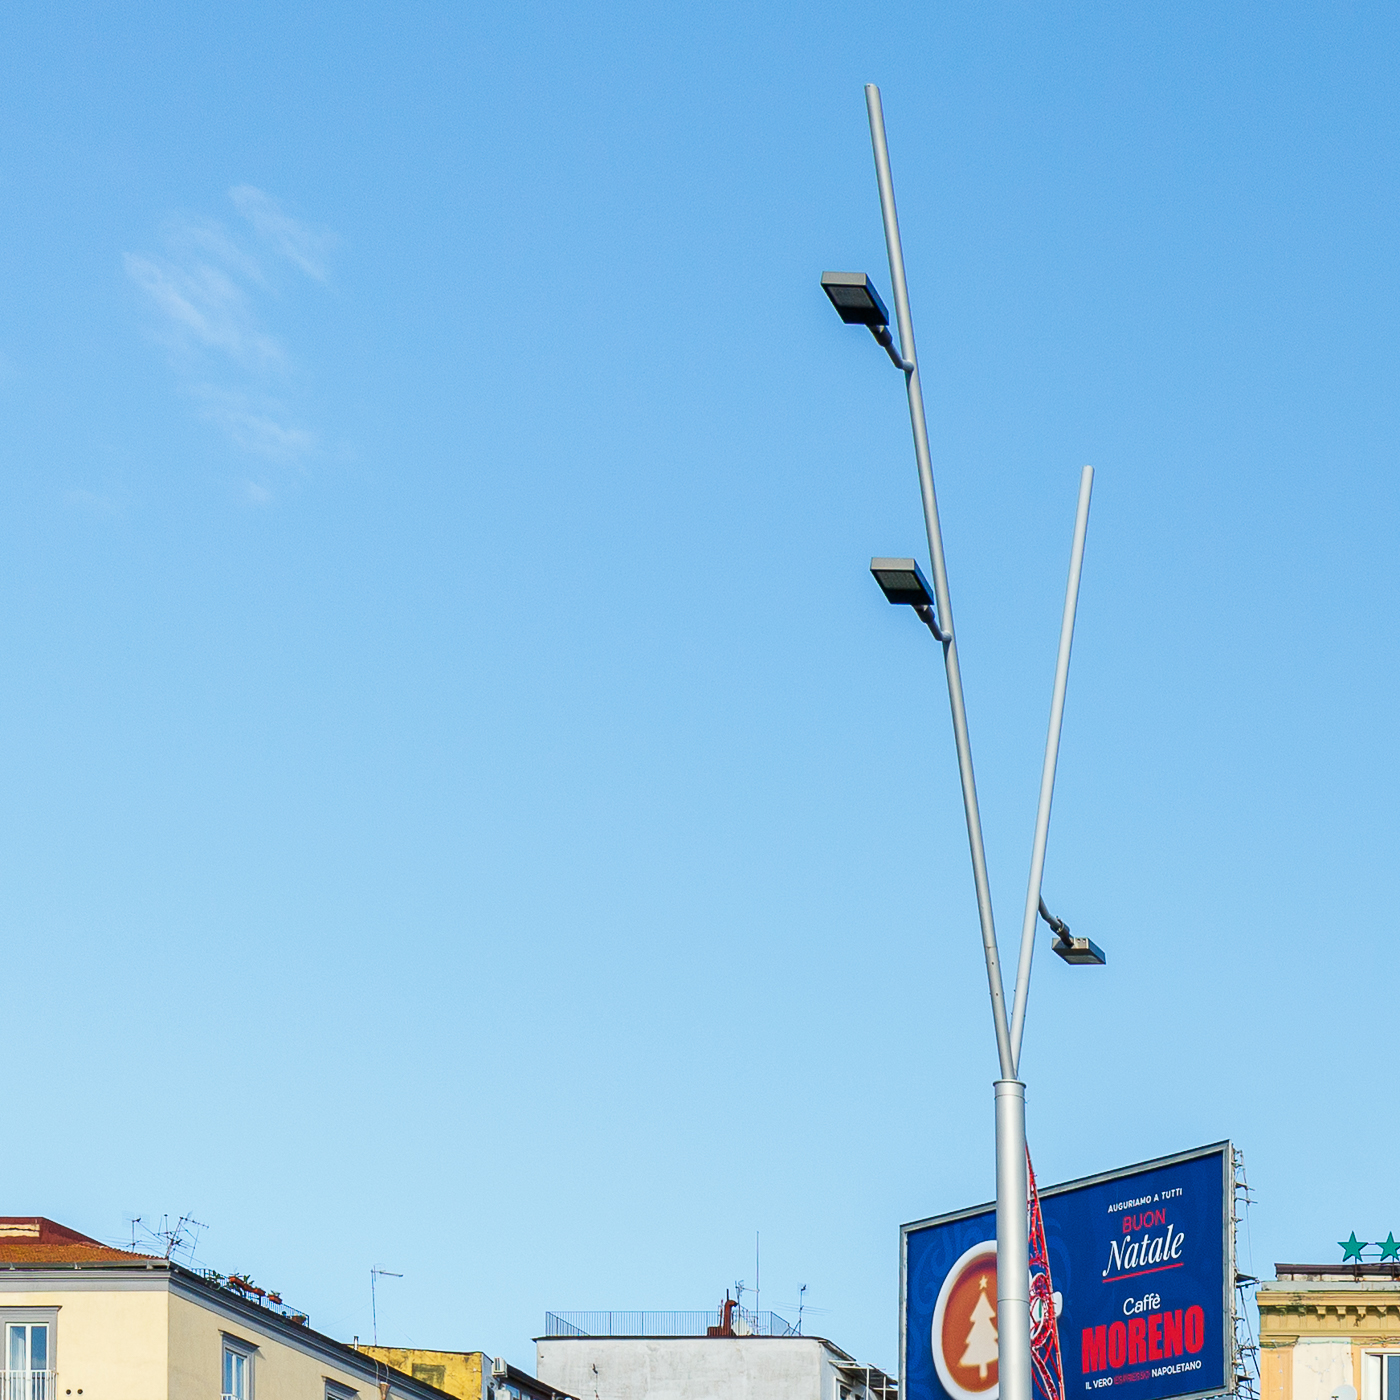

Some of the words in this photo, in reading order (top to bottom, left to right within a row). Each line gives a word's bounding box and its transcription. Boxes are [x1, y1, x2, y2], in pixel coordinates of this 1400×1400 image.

[1107, 1195, 1152, 1213] AUGURIAMO
[1153, 1193, 1160, 1203] A
[1161, 1187, 1183, 1200] TUTTI
[1122, 1208, 1166, 1234] BUON
[1102, 1223, 1185, 1277] Natale
[1123, 1293, 1161, 1316] Caffè
[1082, 1304, 1205, 1374] MORENO
[1085, 1381, 1092, 1390] IL
[1092, 1376, 1113, 1389] VERO
[1151, 1360, 1202, 1378] NAPOLETANO
